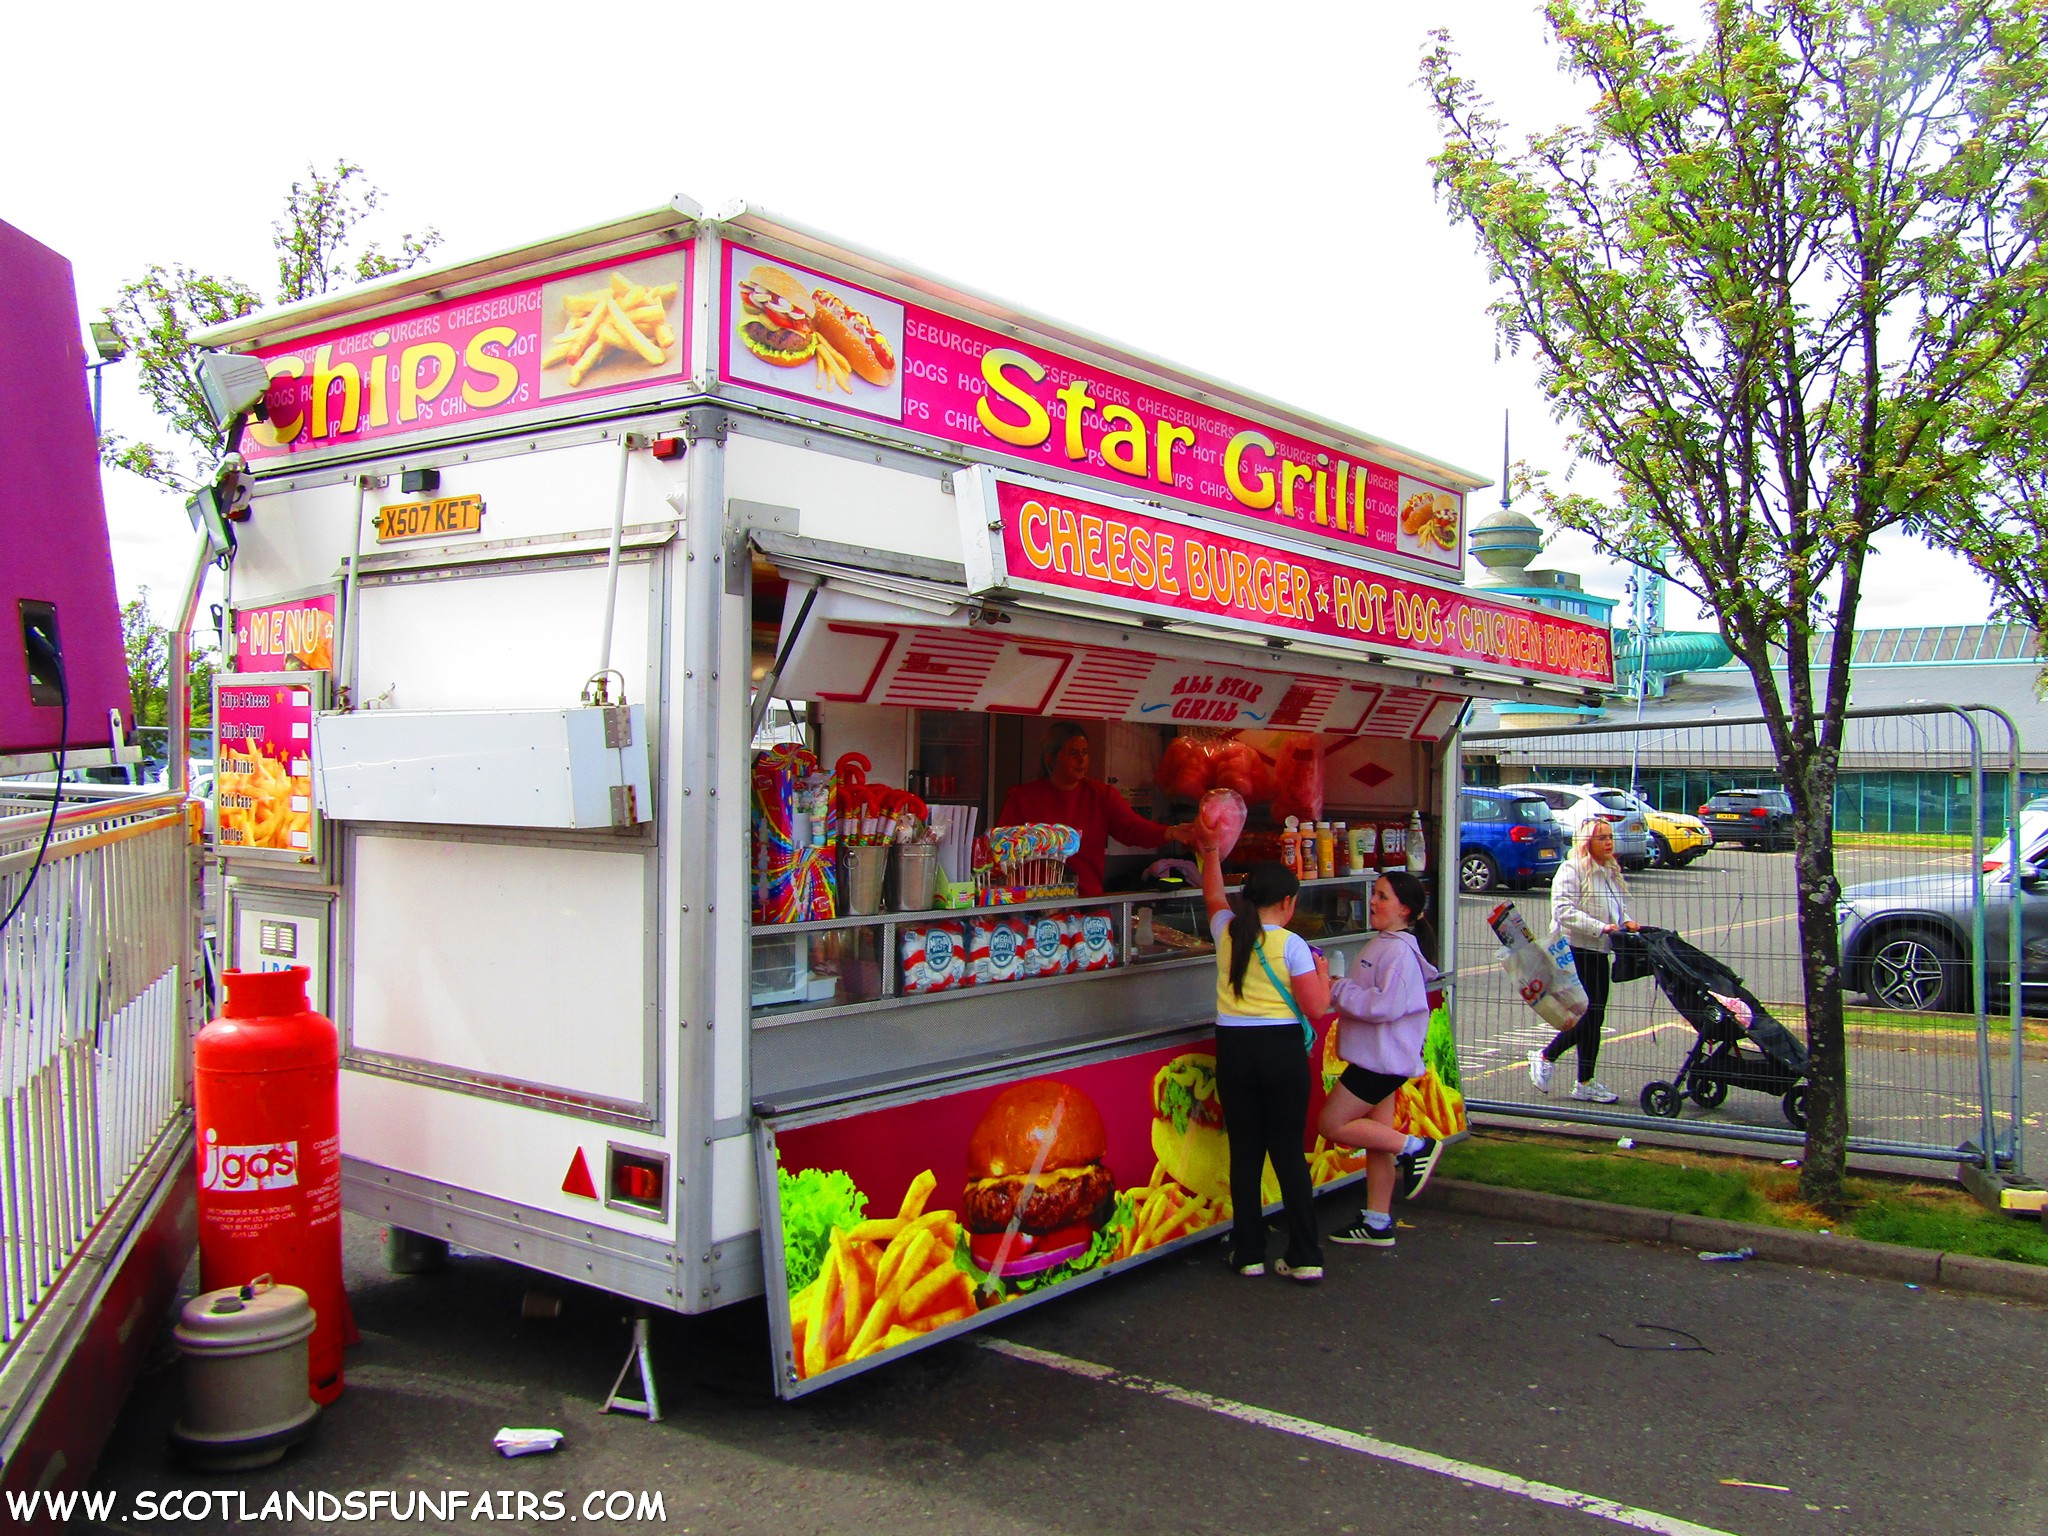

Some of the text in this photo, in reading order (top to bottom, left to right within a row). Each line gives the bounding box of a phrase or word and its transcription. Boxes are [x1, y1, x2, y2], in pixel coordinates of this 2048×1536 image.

[247, 326, 519, 447] Chips
[1137, 396, 1235, 440] CHEESEBURGERS
[976, 348, 1368, 537] Star Grill
[1193, 445, 1217, 463] HOT
[1200, 480, 1233, 502] CHIPS
[386, 500, 471, 536] X507 KET
[1019, 500, 1610, 676] CHEESE BURGER HOT DOG CHICKEN BURGER
[250, 608, 319, 656] MENU
[221, 692, 238, 710] Chips
[245, 692, 270, 708] Cheese
[1215, 677, 1263, 703] STAR
[1172, 698, 1239, 722] GRILL
[221, 722, 238, 741] Chips
[245, 722, 265, 742] Gravy
[221, 759, 254, 773] Hot Drinks
[221, 793, 252, 808] Cold Cans
[220, 827, 243, 841] Bottles
